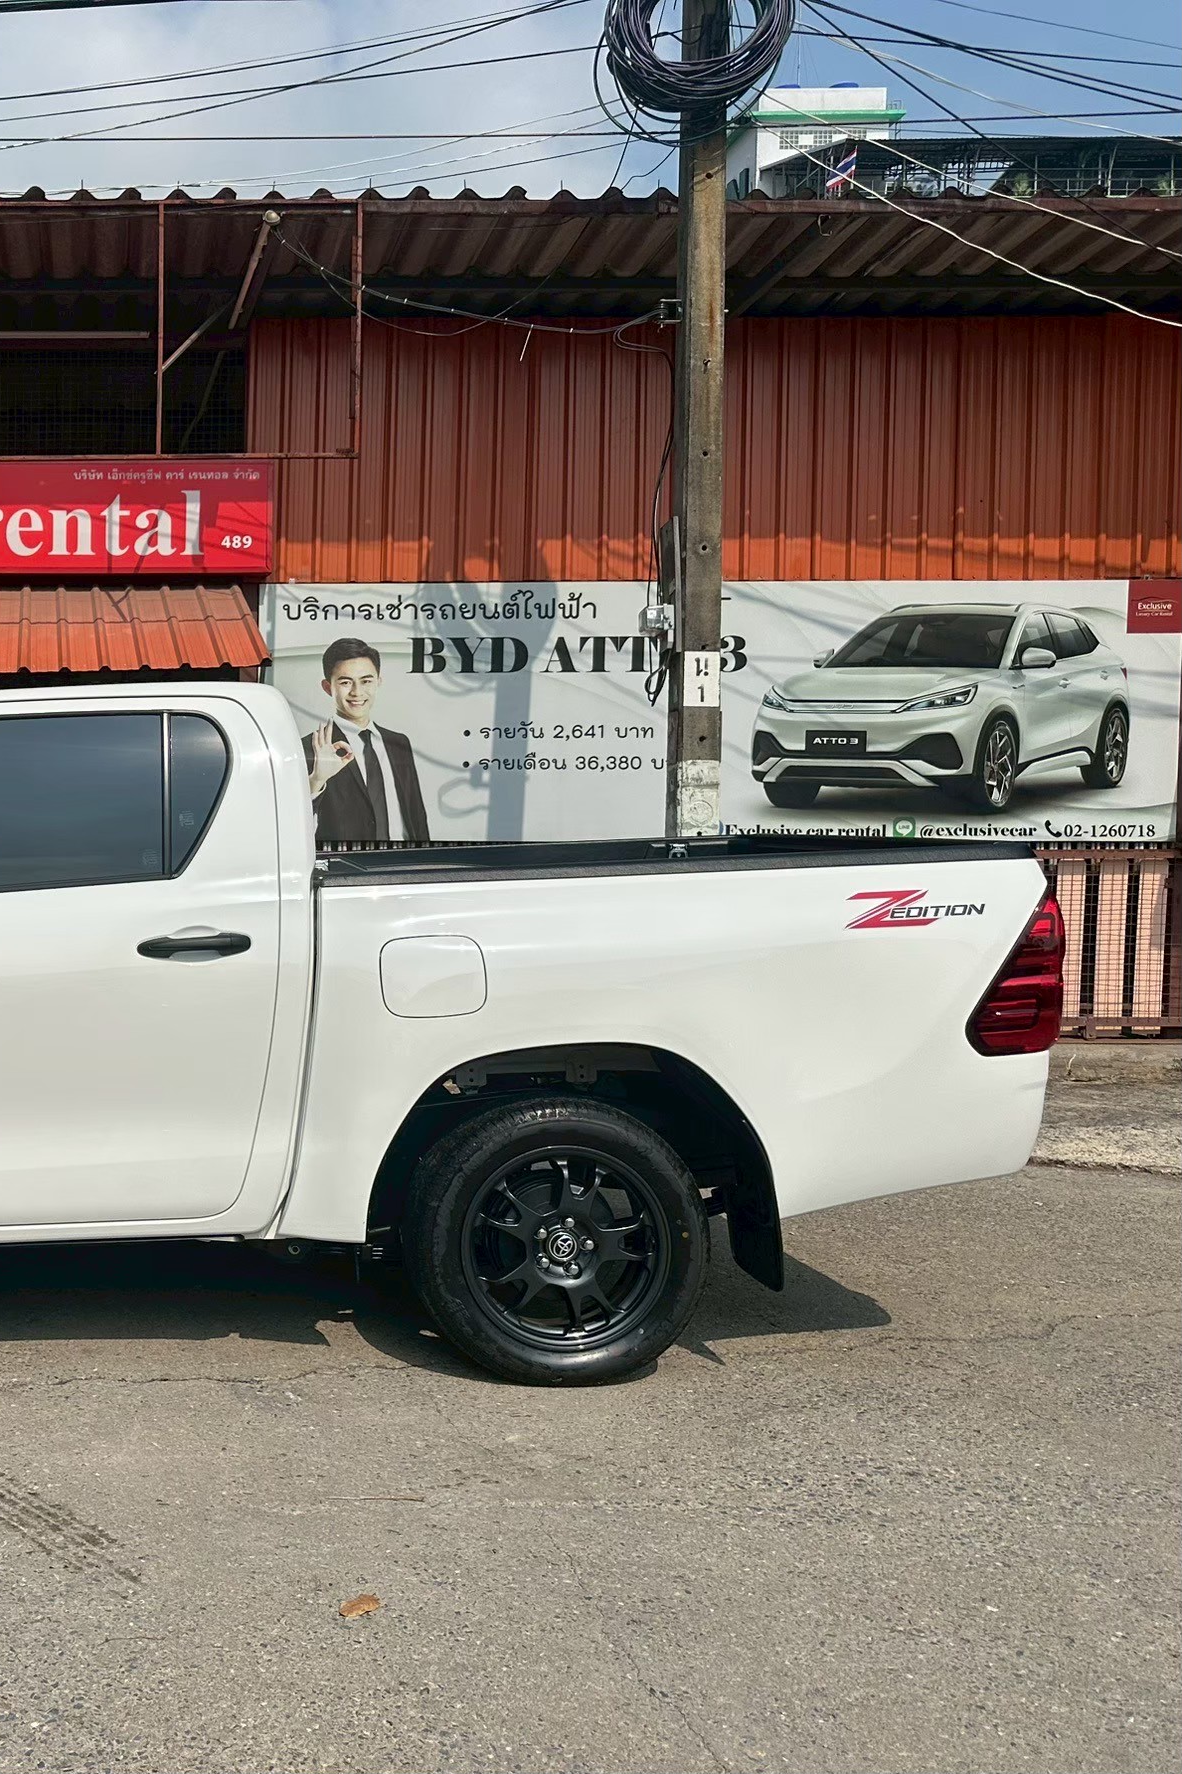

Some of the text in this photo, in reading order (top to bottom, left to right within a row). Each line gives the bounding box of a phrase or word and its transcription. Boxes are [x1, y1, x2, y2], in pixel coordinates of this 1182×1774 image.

[73, 469, 104, 481] บริษัท
[233, 468, 260, 480] จำกัด
[220, 534, 253, 549] 489
[282, 589, 597, 621] บริการเช่ารถยนต์ไฟฟ้า
[1138, 602, 1172, 610] Exclusive
[406, 635, 748, 674] BYD ATT 3
[479, 721, 654, 741] รายวัน 2,641 บาท
[812, 737, 859, 745] ATTO 3
[478, 752, 567, 770] รายเดือน
[575, 756, 642, 772] 36,380
[920, 823, 1037, 838] @exclusivecar
[1063, 824, 1156, 838] 02-1260718
[889, 903, 986, 919] EDITION
